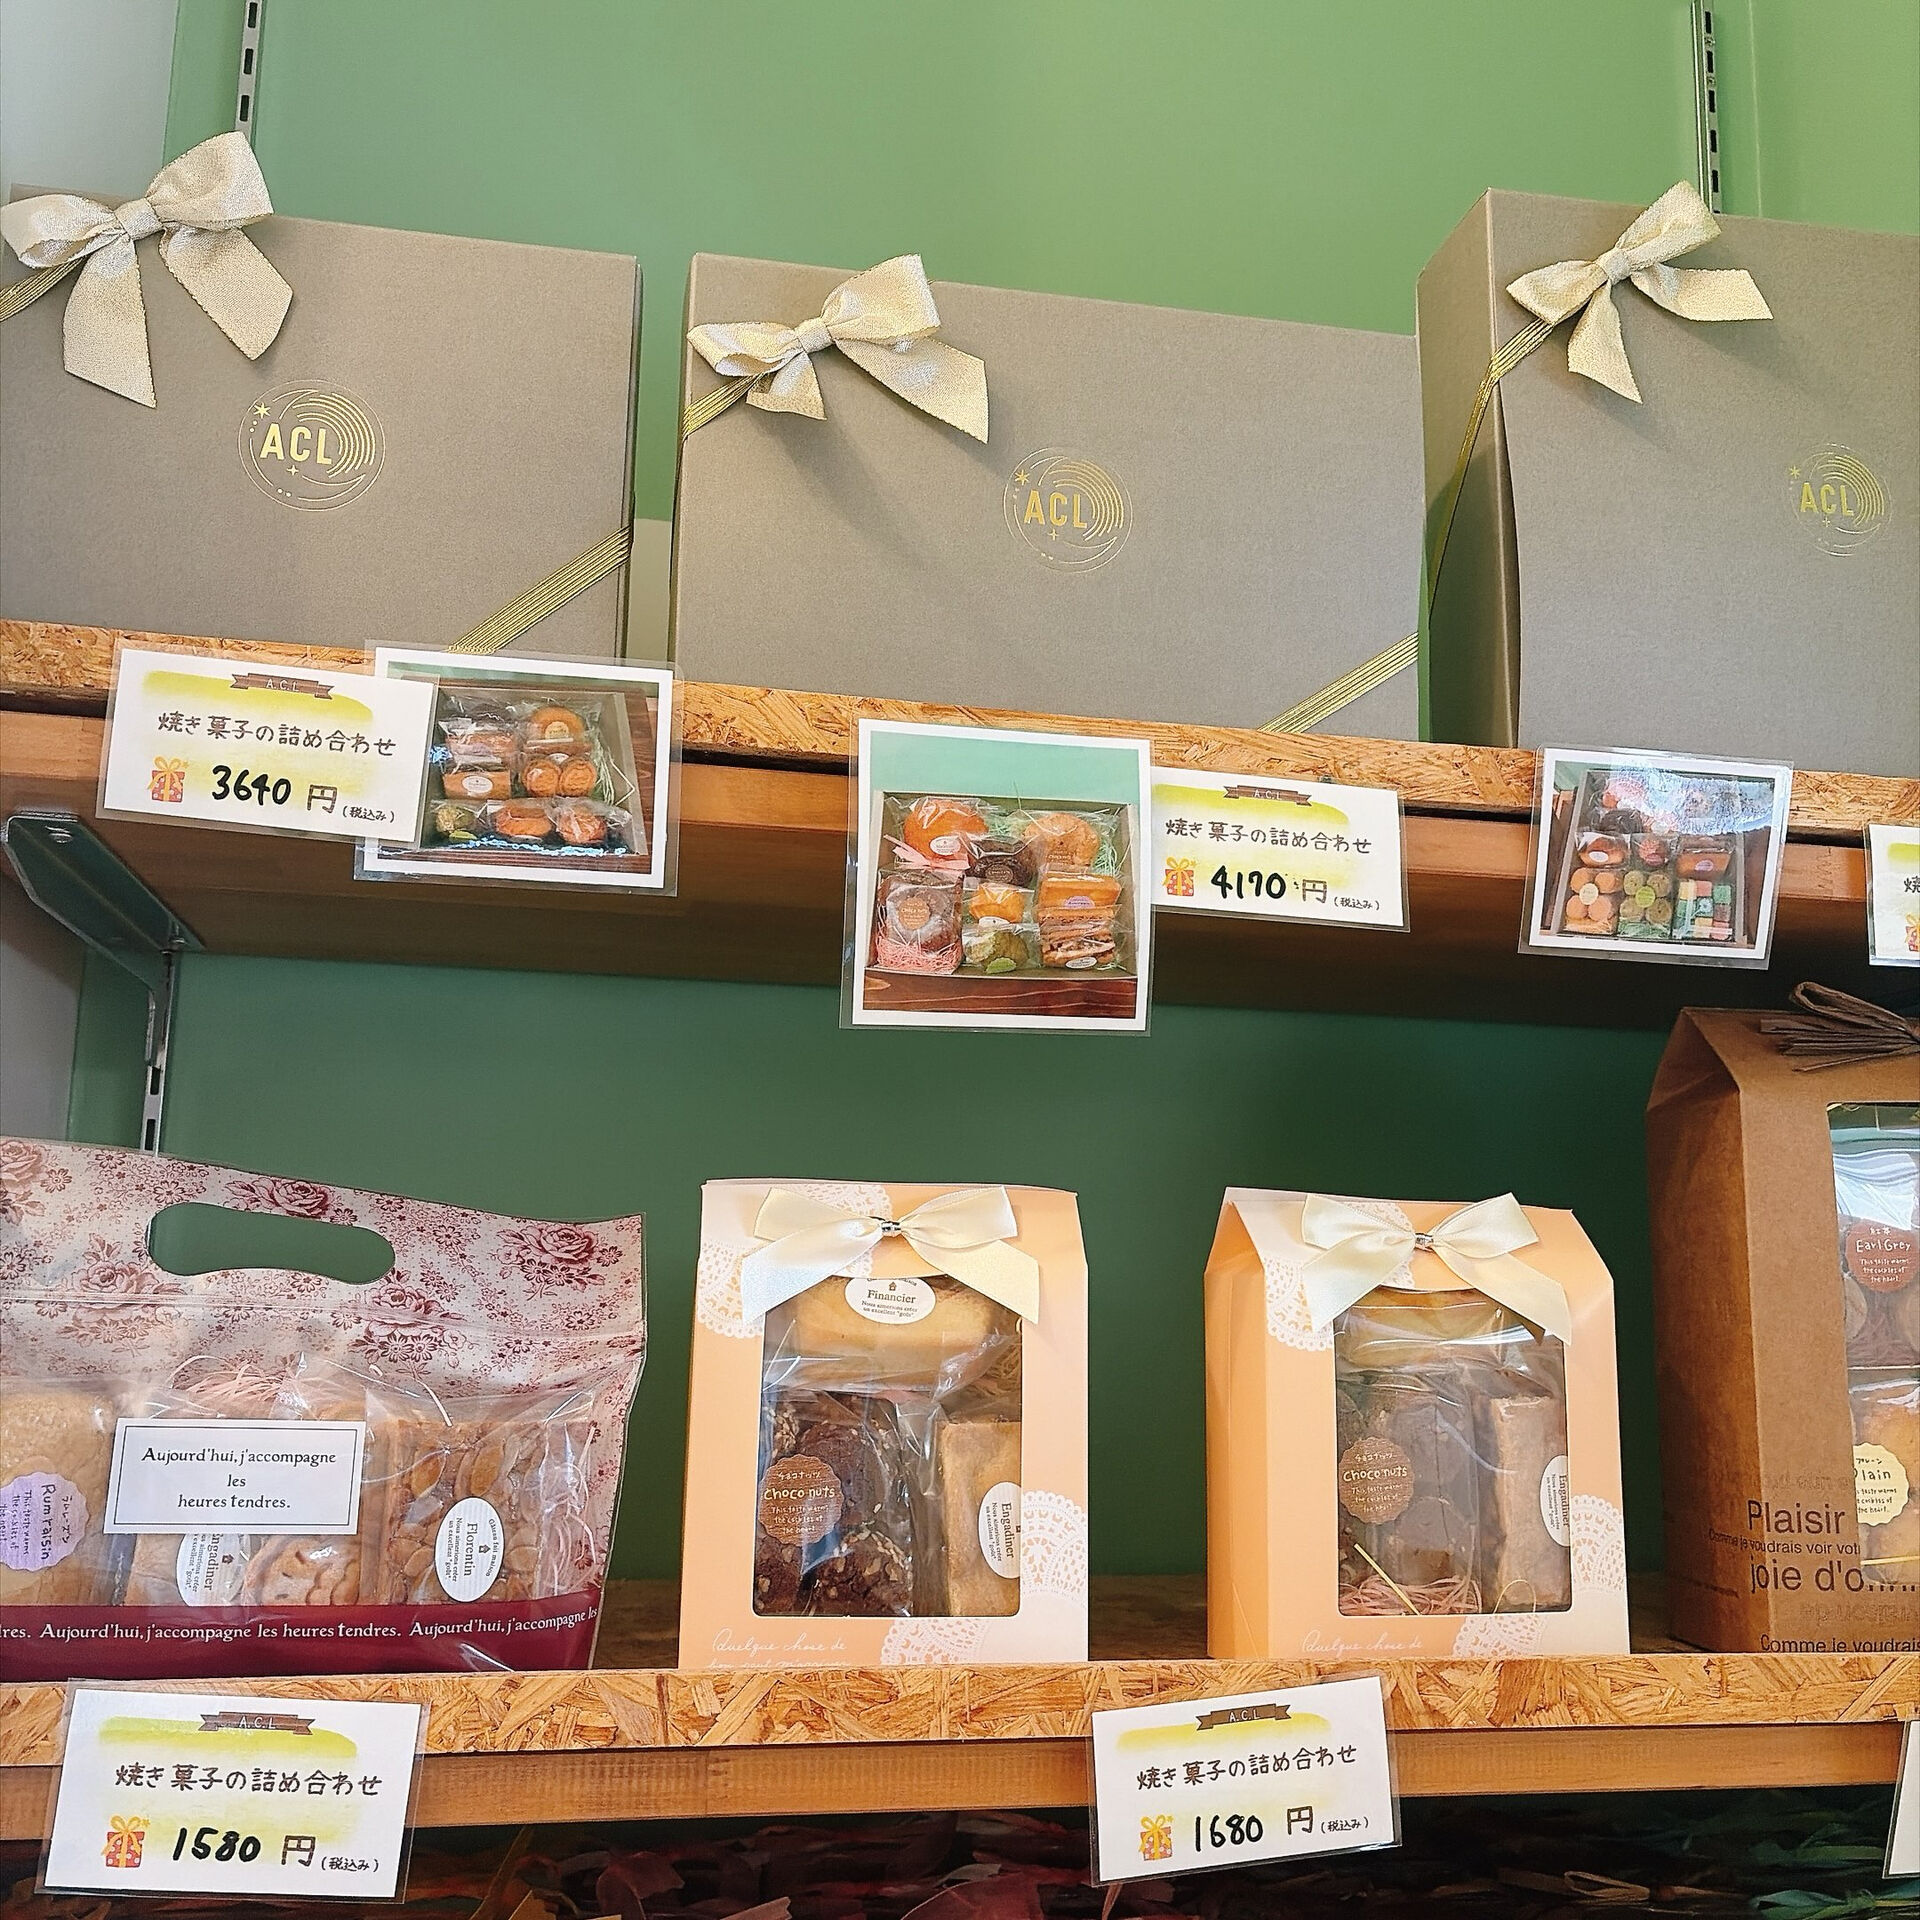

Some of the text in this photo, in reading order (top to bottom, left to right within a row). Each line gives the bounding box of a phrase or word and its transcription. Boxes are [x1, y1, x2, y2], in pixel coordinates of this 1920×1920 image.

[259, 422, 333, 465] ACL
[1023, 489, 1088, 529] ACL
[1800, 482, 1854, 517] ACL
[211, 765, 292, 806] 3640
[306, 784, 338, 814] 円
[1211, 865, 1287, 899] 4170
[1301, 879, 1328, 904] 円
[1856, 1239, 1911, 1253] Earl Grey
[867, 1289, 916, 1304] Financier
[227, 1474, 246, 1488] les
[1383, 1466, 1408, 1477] nuts
[177, 1494, 291, 1509] heures tendres.
[808, 1485, 835, 1499] nuts
[40, 1484, 57, 1560] Rum raisin
[1000, 1502, 1016, 1558] Engadiner
[1747, 1500, 1845, 1534] Plaisir
[464, 1523, 478, 1576] Florentin
[1750, 1540, 1801, 1554] voudrais
[1806, 1541, 1836, 1555] voir
[1750, 1556, 1801, 1594] joie
[257, 1623, 278, 1638] les
[283, 1622, 334, 1638] heures
[338, 1621, 402, 1638] tendres.
[588, 1606, 598, 1620] les
[831, 1637, 847, 1651] de
[1760, 1634, 1826, 1652] Comme
[1195, 1814, 1263, 1852] 1680
[1287, 1805, 1313, 1835] 円
[172, 1827, 261, 1863] 1580
[281, 1834, 316, 1866] 円
